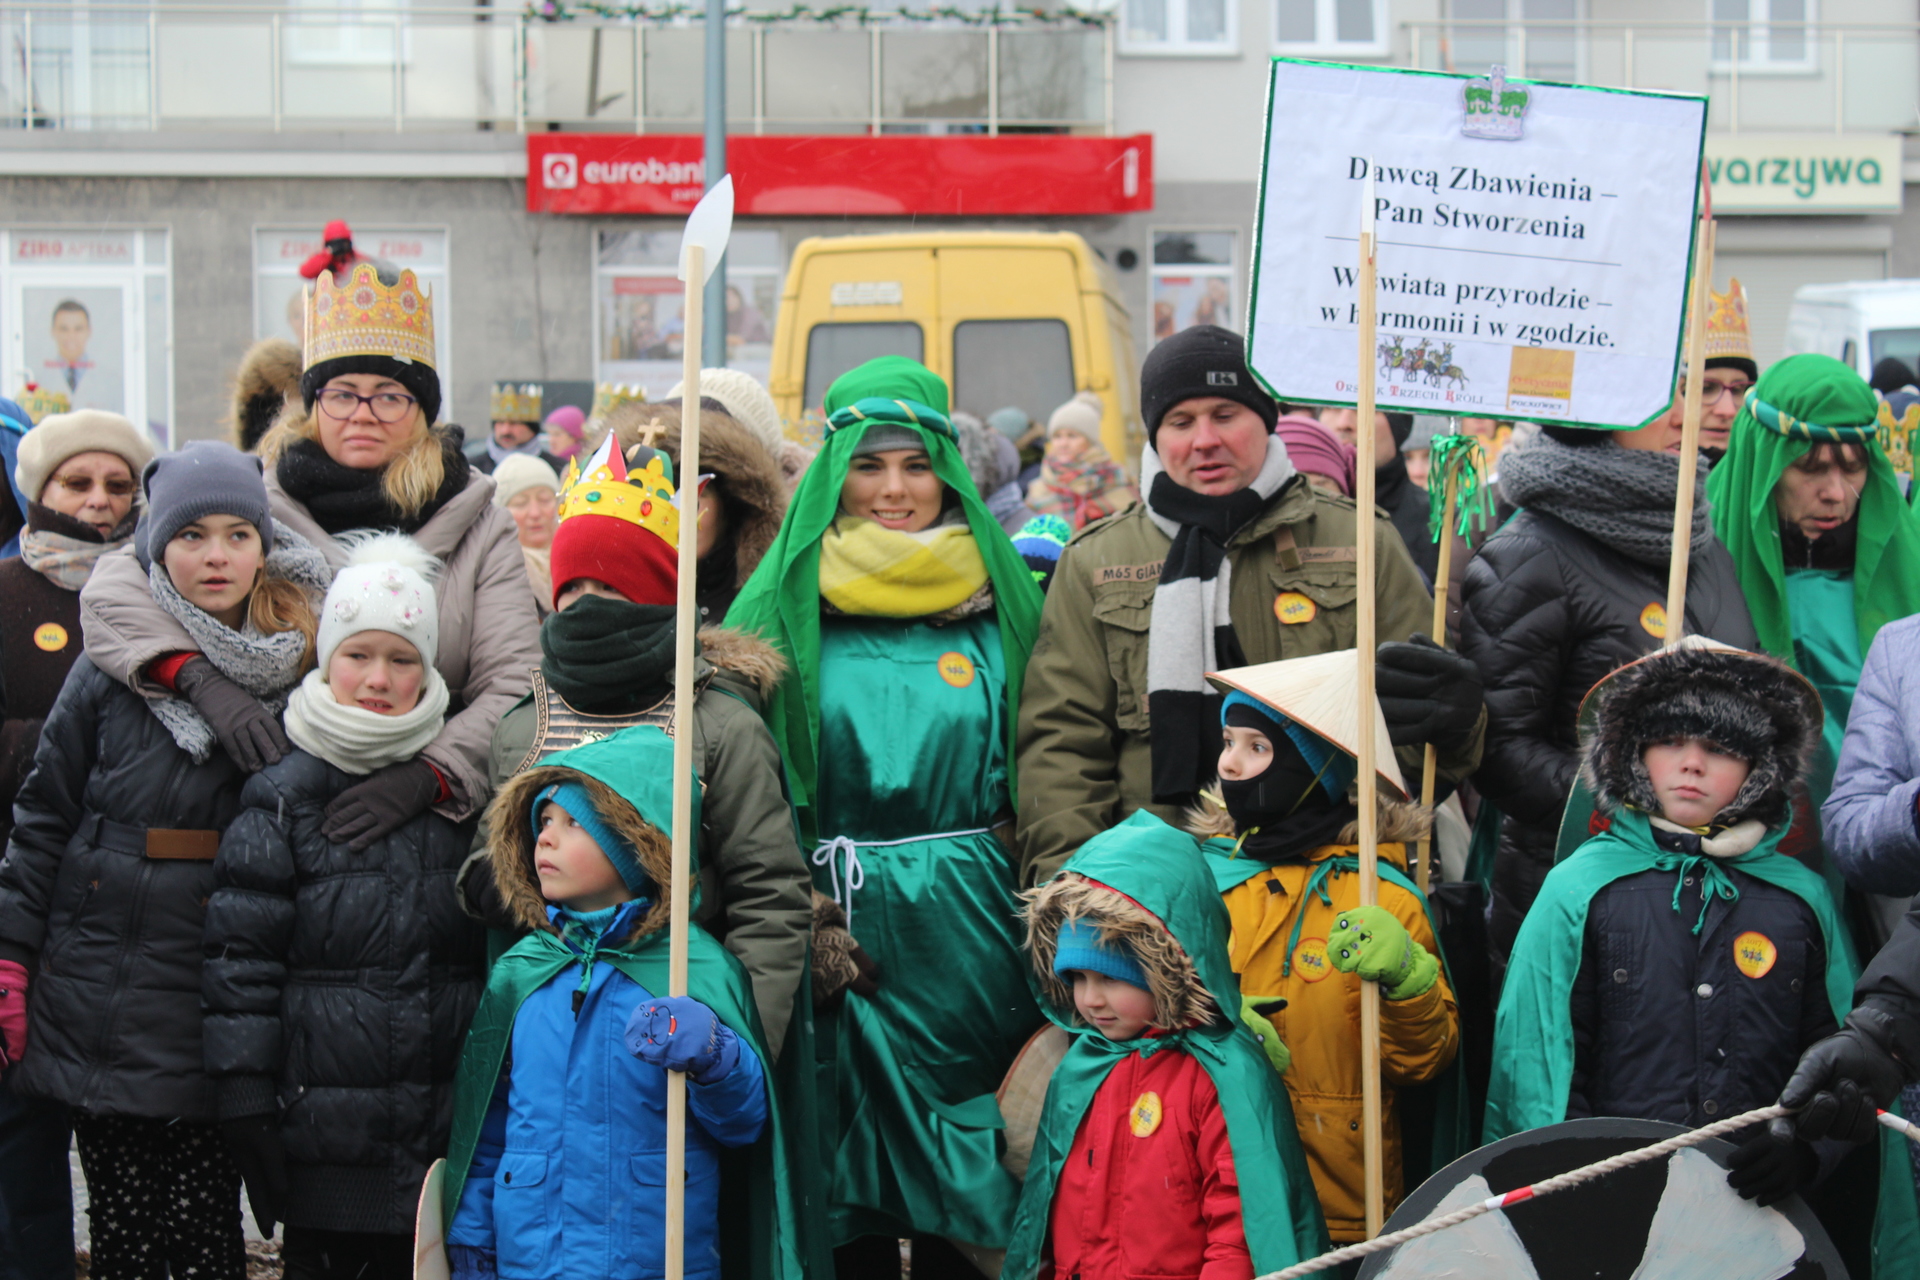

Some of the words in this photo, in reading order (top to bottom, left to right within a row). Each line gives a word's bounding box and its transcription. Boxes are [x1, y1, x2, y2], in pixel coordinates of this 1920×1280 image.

[1347, 156, 1440, 194] Dawcą
[1448, 166, 1593, 202] Zbawienia
[1374, 197, 1423, 225] Pan
[1433, 203, 1586, 240] Stworzenia
[1332, 266, 1360, 288] W
[1374, 268, 1447, 298] wiata
[1455, 283, 1590, 310] przyrodzie
[1320, 306, 1341, 322] w
[1348, 303, 1465, 335] hrmonii
[1471, 314, 1480, 336] i
[1488, 320, 1509, 338] w
[1515, 323, 1616, 348] zgodzie.
[1336, 380, 1385, 396] ORSK
[1389, 385, 1440, 401] TRZECH
[1103, 567, 1131, 581] M65
